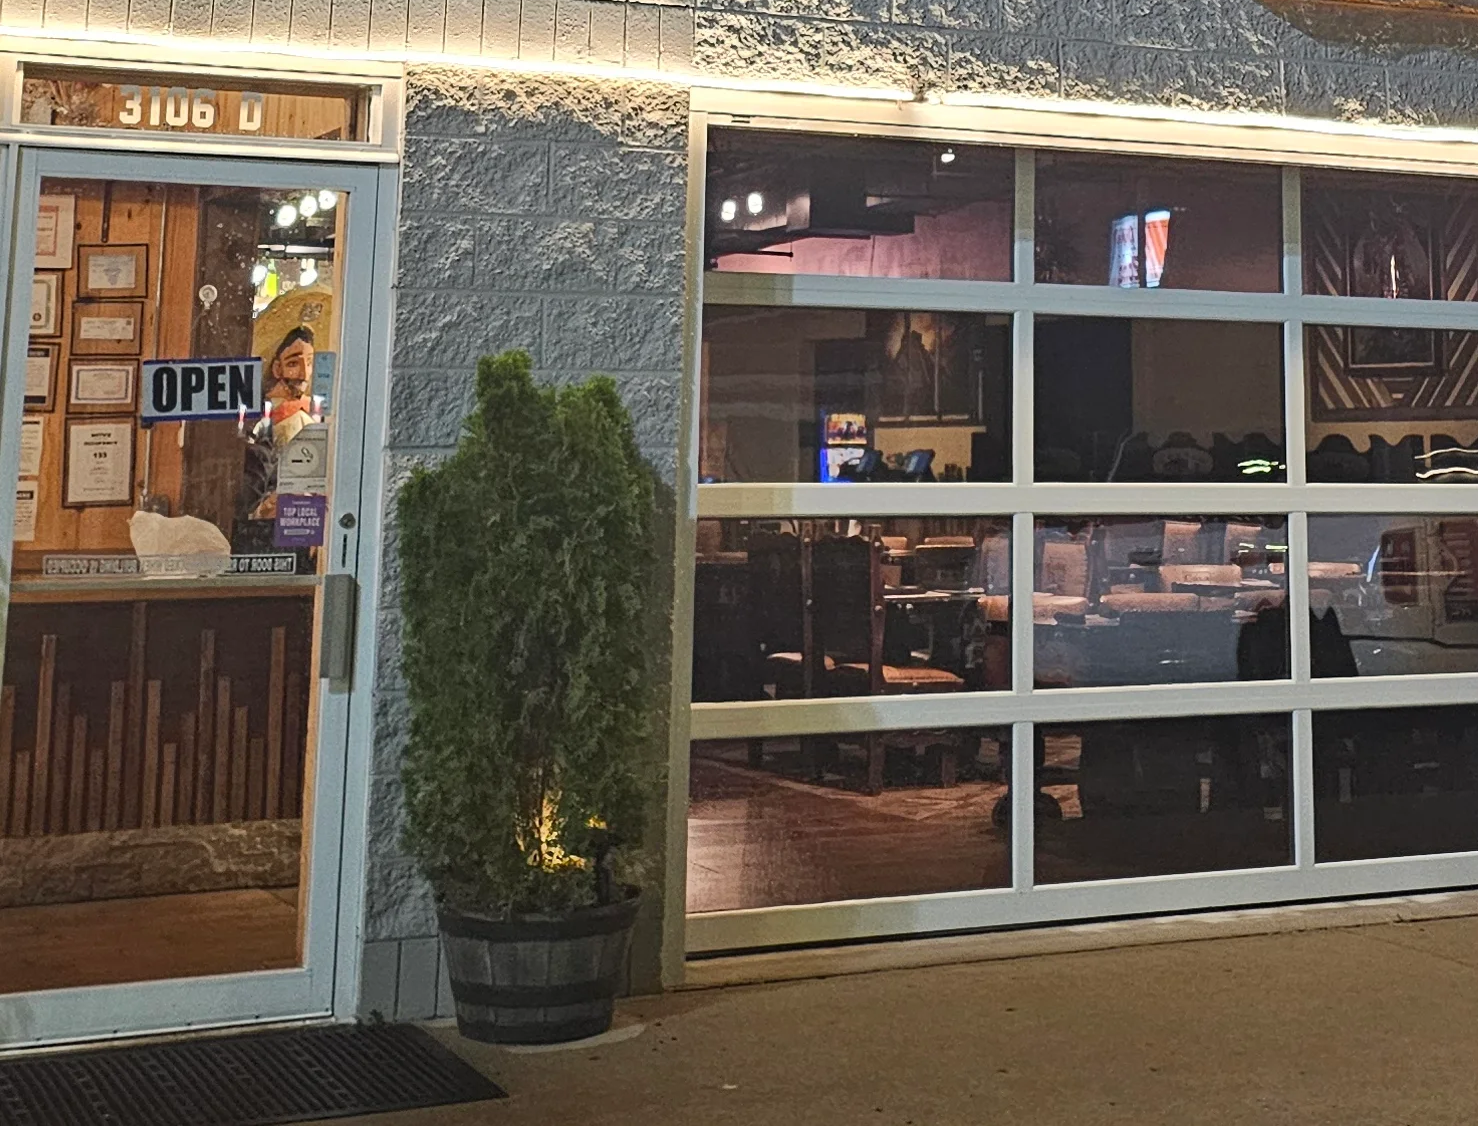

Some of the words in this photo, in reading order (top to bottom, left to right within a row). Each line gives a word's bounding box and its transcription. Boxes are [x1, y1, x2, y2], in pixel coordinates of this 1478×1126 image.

[119, 84, 216, 129] 3106
[152, 364, 255, 413] OPEN
[279, 517, 321, 527] WORKPLACE
[283, 507, 297, 517] TOP
[297, 507, 318, 517] LOCAL
